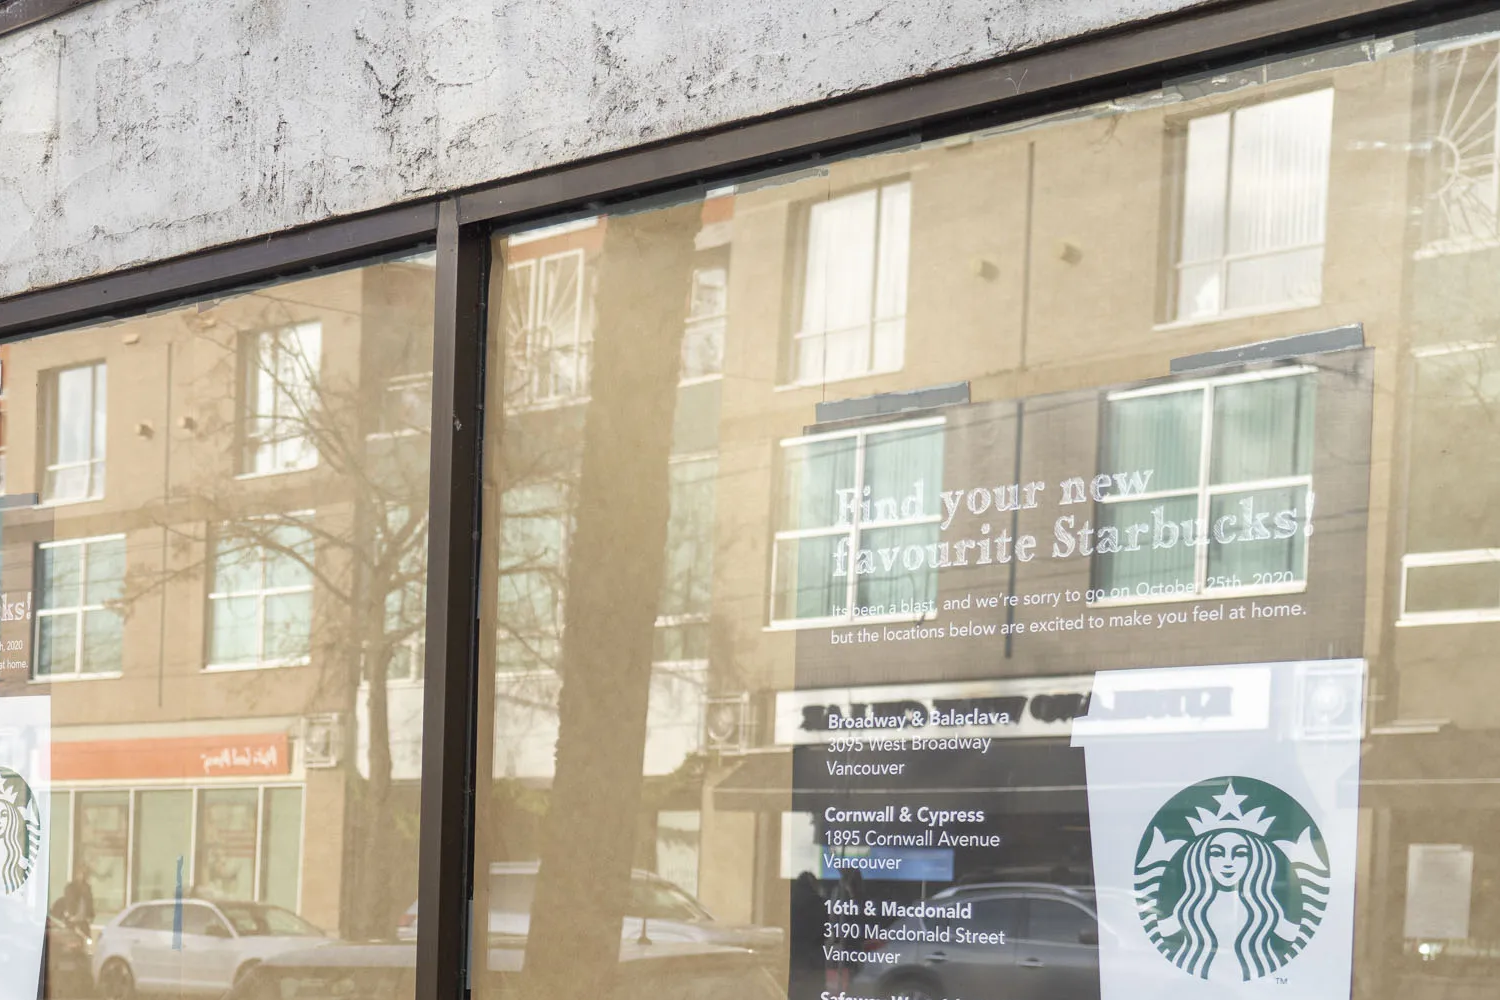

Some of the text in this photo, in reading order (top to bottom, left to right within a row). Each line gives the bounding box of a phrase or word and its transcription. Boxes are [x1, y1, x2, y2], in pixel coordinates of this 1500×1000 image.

[835, 468, 1154, 531] Find your new
[832, 490, 1316, 577] favourite Starbucks!
[832, 604, 848, 618] Its
[853, 602, 885, 617] been
[889, 603, 898, 615] a
[901, 597, 938, 615] blast,
[943, 593, 971, 611] and
[1023, 592, 1061, 608] sorry
[1065, 588, 1081, 603] to
[1085, 588, 1105, 606] go
[1110, 585, 1131, 599] on
[1136, 580, 1199, 597] October
[1252, 570, 1295, 586] 2020
[831, 601, 1308, 645] but the locations below are excited to make you feel at home.
[7, 640, 24, 651] 2020
[0, 659, 6, 670] at
[7, 658, 29, 669] home.
[828, 711, 906, 732] Broadway
[911, 711, 925, 727] &
[929, 707, 1010, 726] Balaclava
[827, 734, 992, 754] 3095 West Broadway
[826, 760, 905, 776] Vancouver
[824, 805, 986, 827] Cornwall & Cypress
[825, 829, 1001, 848] 1895 Cornwall Avenue
[823, 853, 902, 870] Vancouver
[823, 899, 972, 920] 16th & Macdonald
[823, 922, 1006, 945] 3190 Macdonald Street
[822, 945, 901, 964] Vancouver
